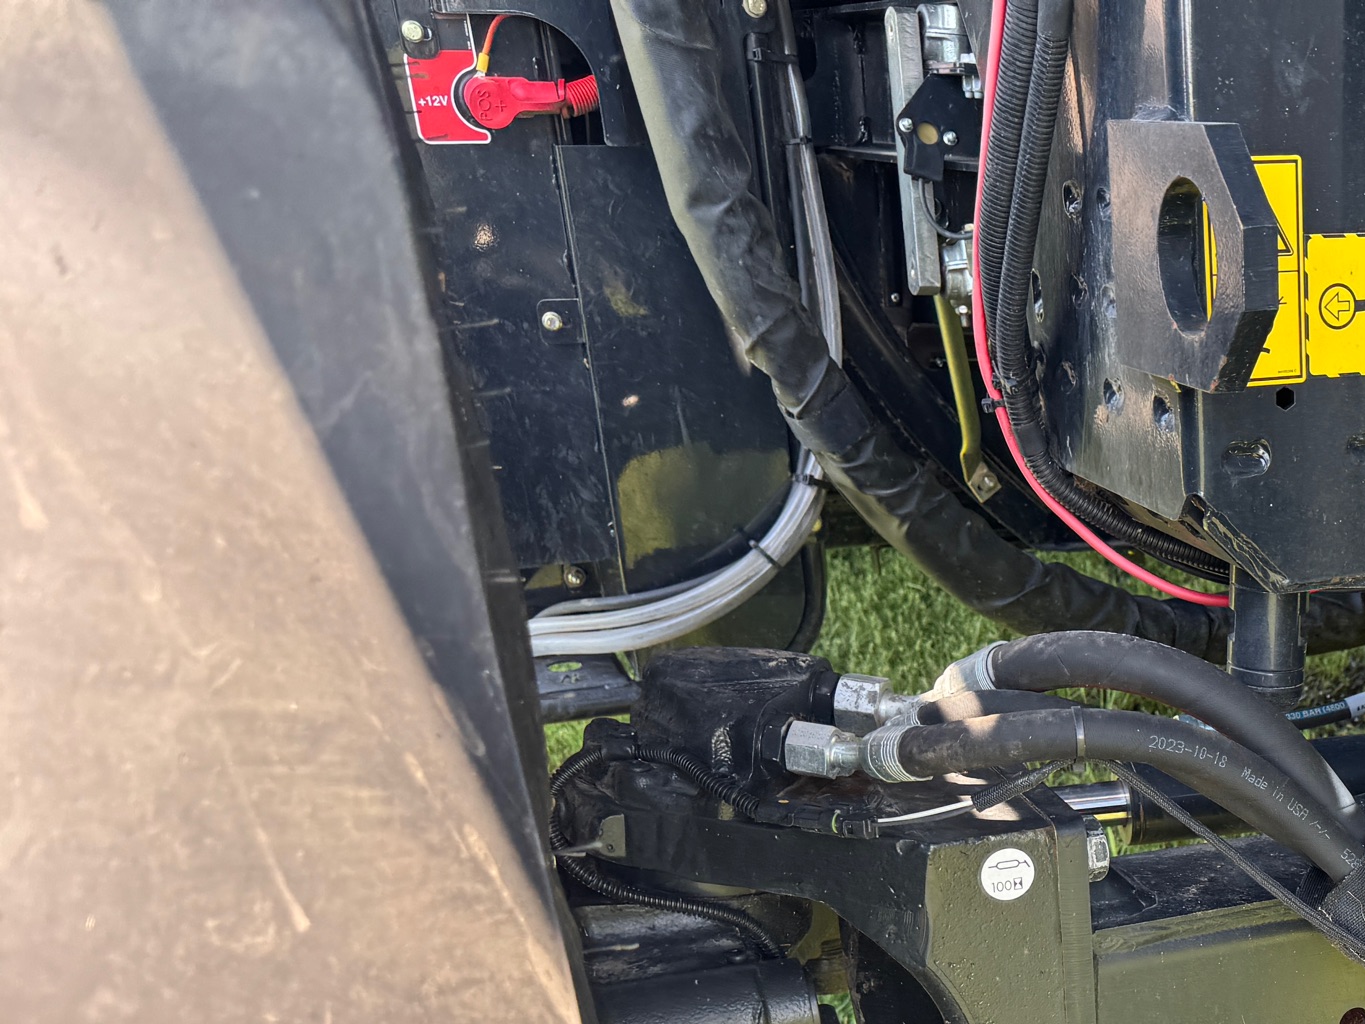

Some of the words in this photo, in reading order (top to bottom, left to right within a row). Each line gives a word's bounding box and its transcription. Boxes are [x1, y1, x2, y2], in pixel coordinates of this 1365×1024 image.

[418, 95, 448, 107] +12V
[477, 90, 493, 121] POS
[1302, 707, 1322, 718] BAR
[1148, 735, 1228, 768] 2023-10-18
[1241, 766, 1268, 790] Made
[1272, 786, 1284, 802] in
[1287, 797, 1310, 821] USA
[991, 880, 1012, 893] 100
